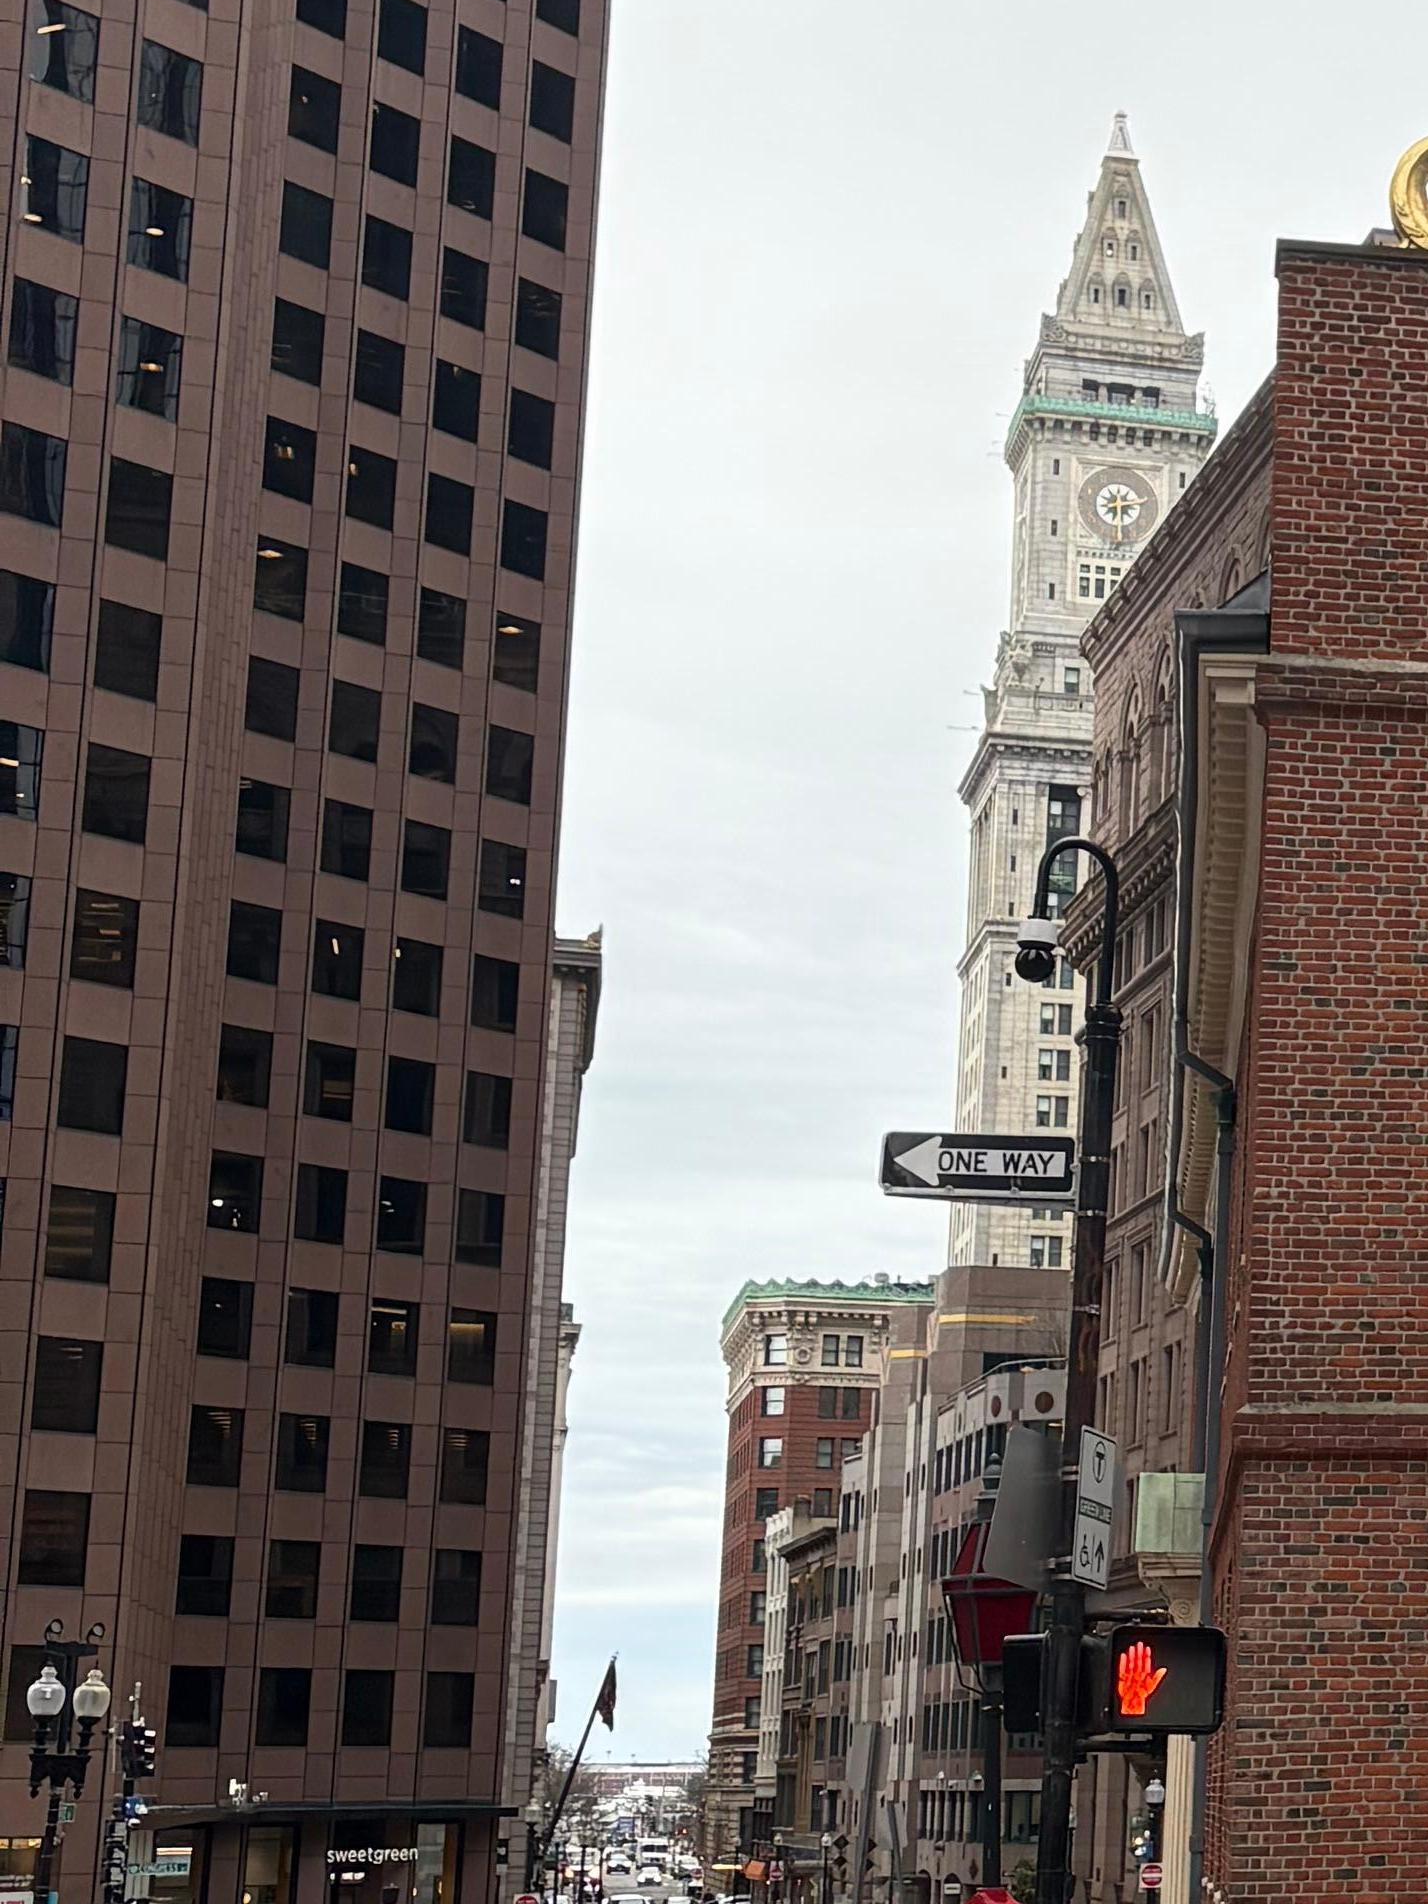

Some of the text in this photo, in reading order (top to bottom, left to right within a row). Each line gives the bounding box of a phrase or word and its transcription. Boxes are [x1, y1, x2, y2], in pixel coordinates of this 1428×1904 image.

[938, 1150, 1054, 1176] ONE WAY
[326, 1846, 419, 1865] sweetgreen
